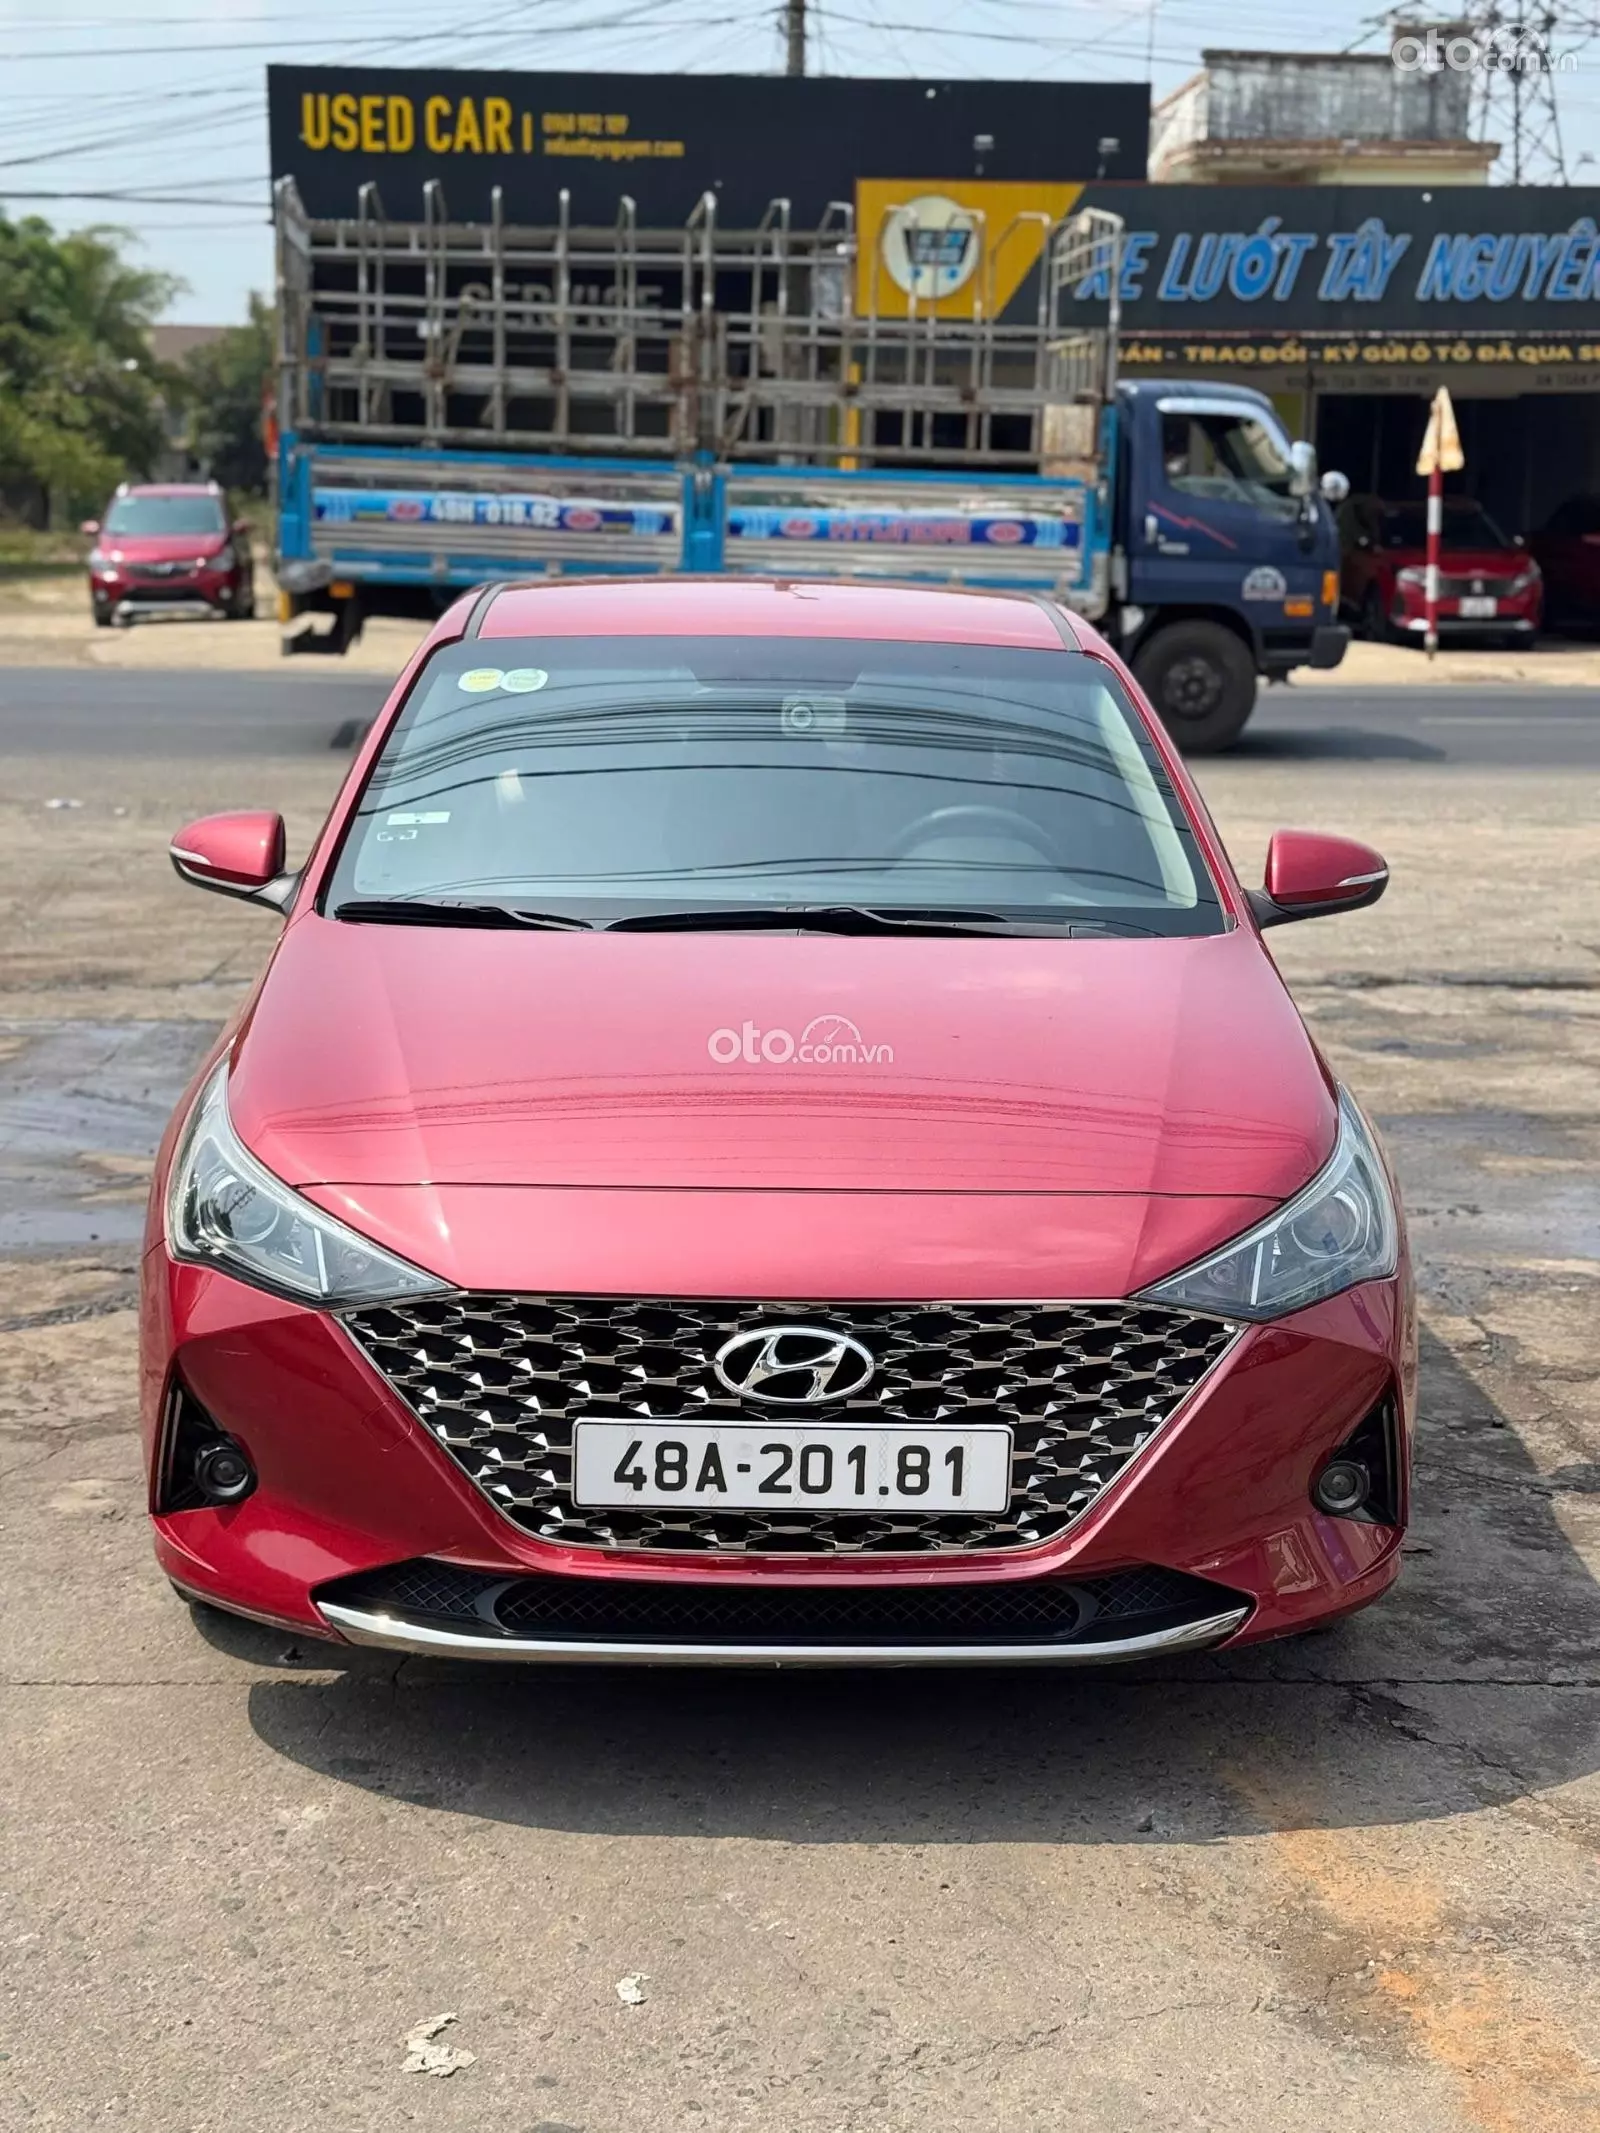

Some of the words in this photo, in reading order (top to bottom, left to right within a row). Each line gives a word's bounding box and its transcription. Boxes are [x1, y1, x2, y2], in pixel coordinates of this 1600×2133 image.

[302, 92, 415, 152] USED
[424, 95, 513, 154] CAR
[1074, 232, 1158, 300] XE
[1156, 216, 1318, 301] LƯỚT
[1318, 217, 1412, 301] TÂY
[1184, 346, 1256, 363] TRAO
[1435, 341, 1473, 363] TÔ
[1517, 345, 1573, 364] QUA
[613, 1440, 966, 1497] 48A-201.81
